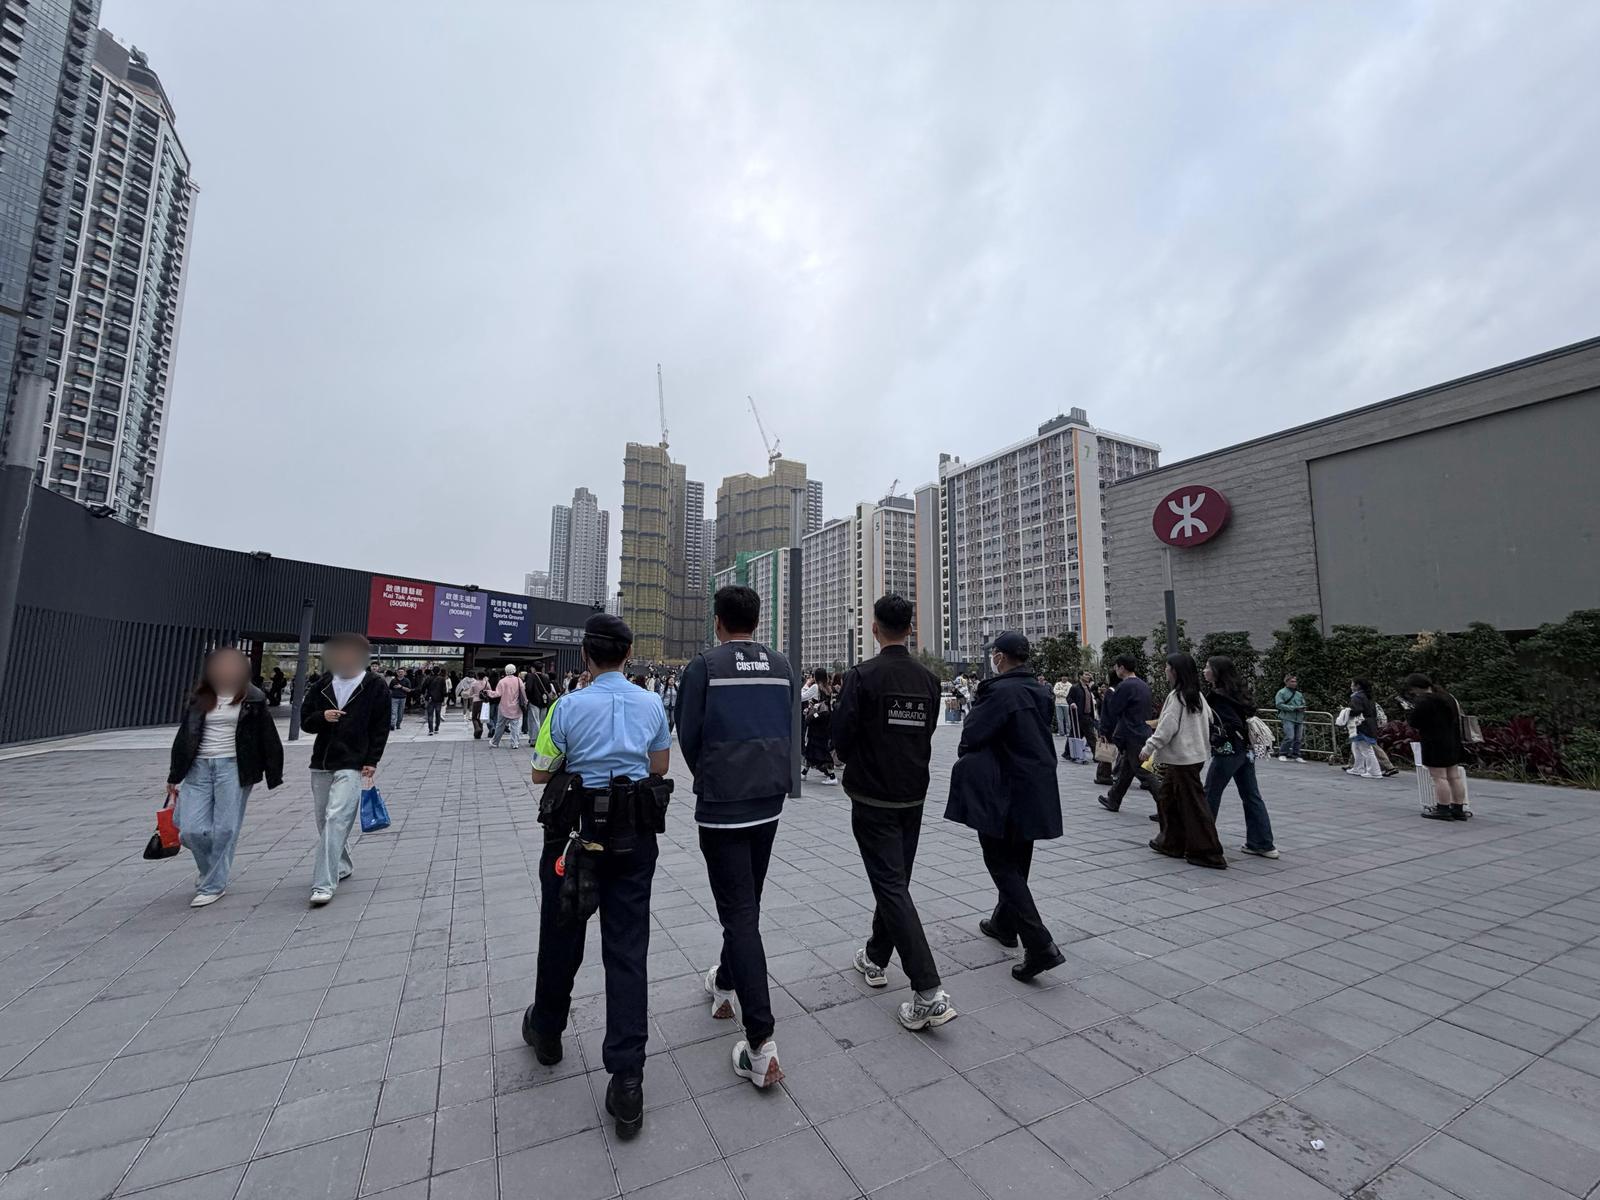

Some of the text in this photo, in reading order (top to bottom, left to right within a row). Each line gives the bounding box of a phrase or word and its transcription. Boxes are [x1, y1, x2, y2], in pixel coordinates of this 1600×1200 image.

[395, 593, 406, 601] Tak
[736, 661, 770, 671] CUSTOMS
[888, 709, 927, 720] IMMIGRATION
